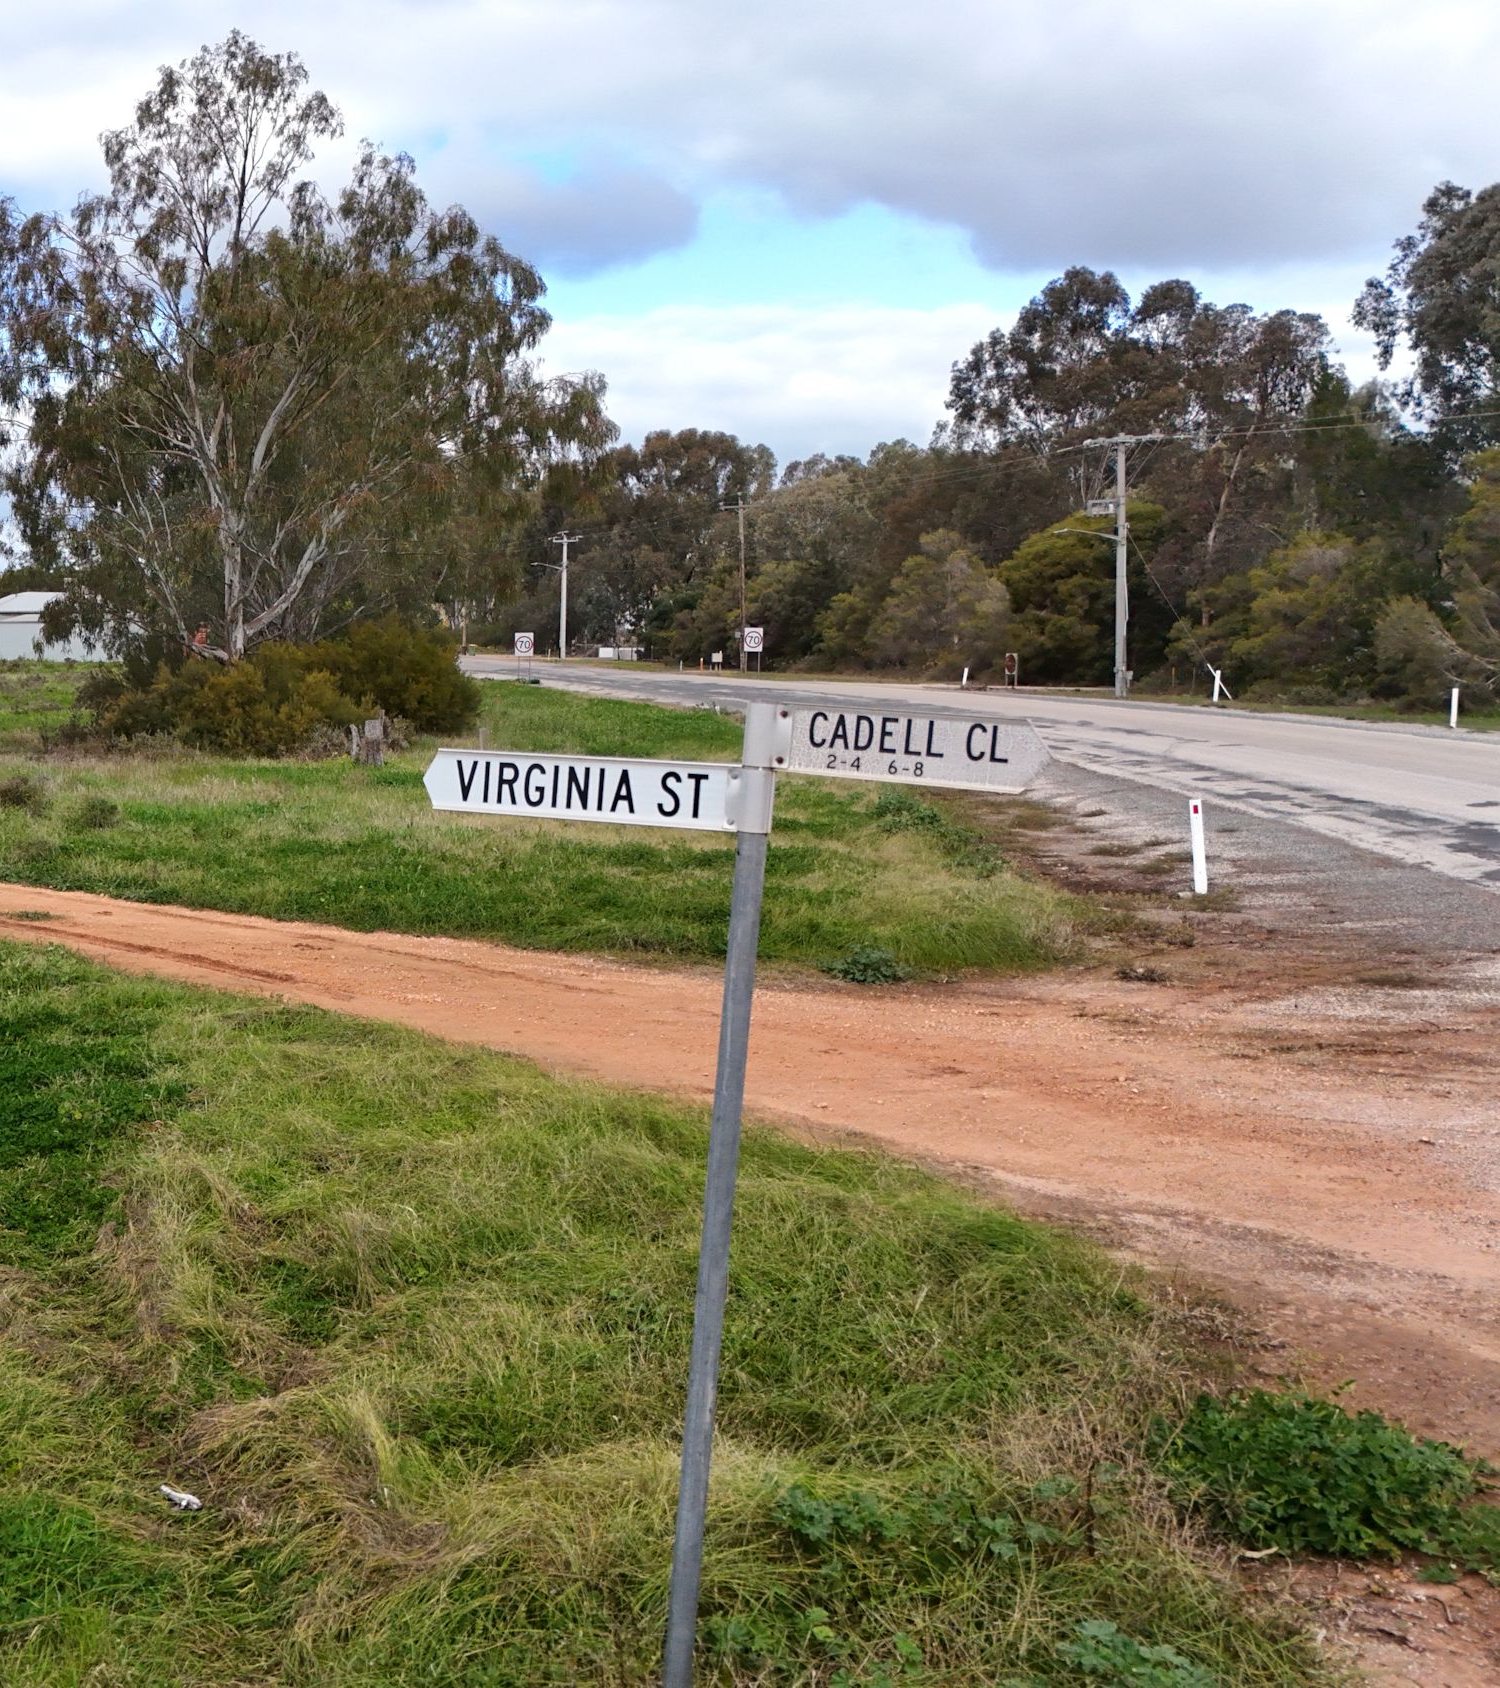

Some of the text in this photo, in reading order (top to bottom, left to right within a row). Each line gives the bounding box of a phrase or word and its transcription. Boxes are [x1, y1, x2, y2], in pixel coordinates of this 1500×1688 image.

[518, 640, 531, 649] 70
[748, 635, 760, 644] 70
[809, 711, 1009, 764] CADELL CL
[826, 754, 924, 777] 2-4 6-8
[456, 759, 709, 819] VIRGINIA ST
